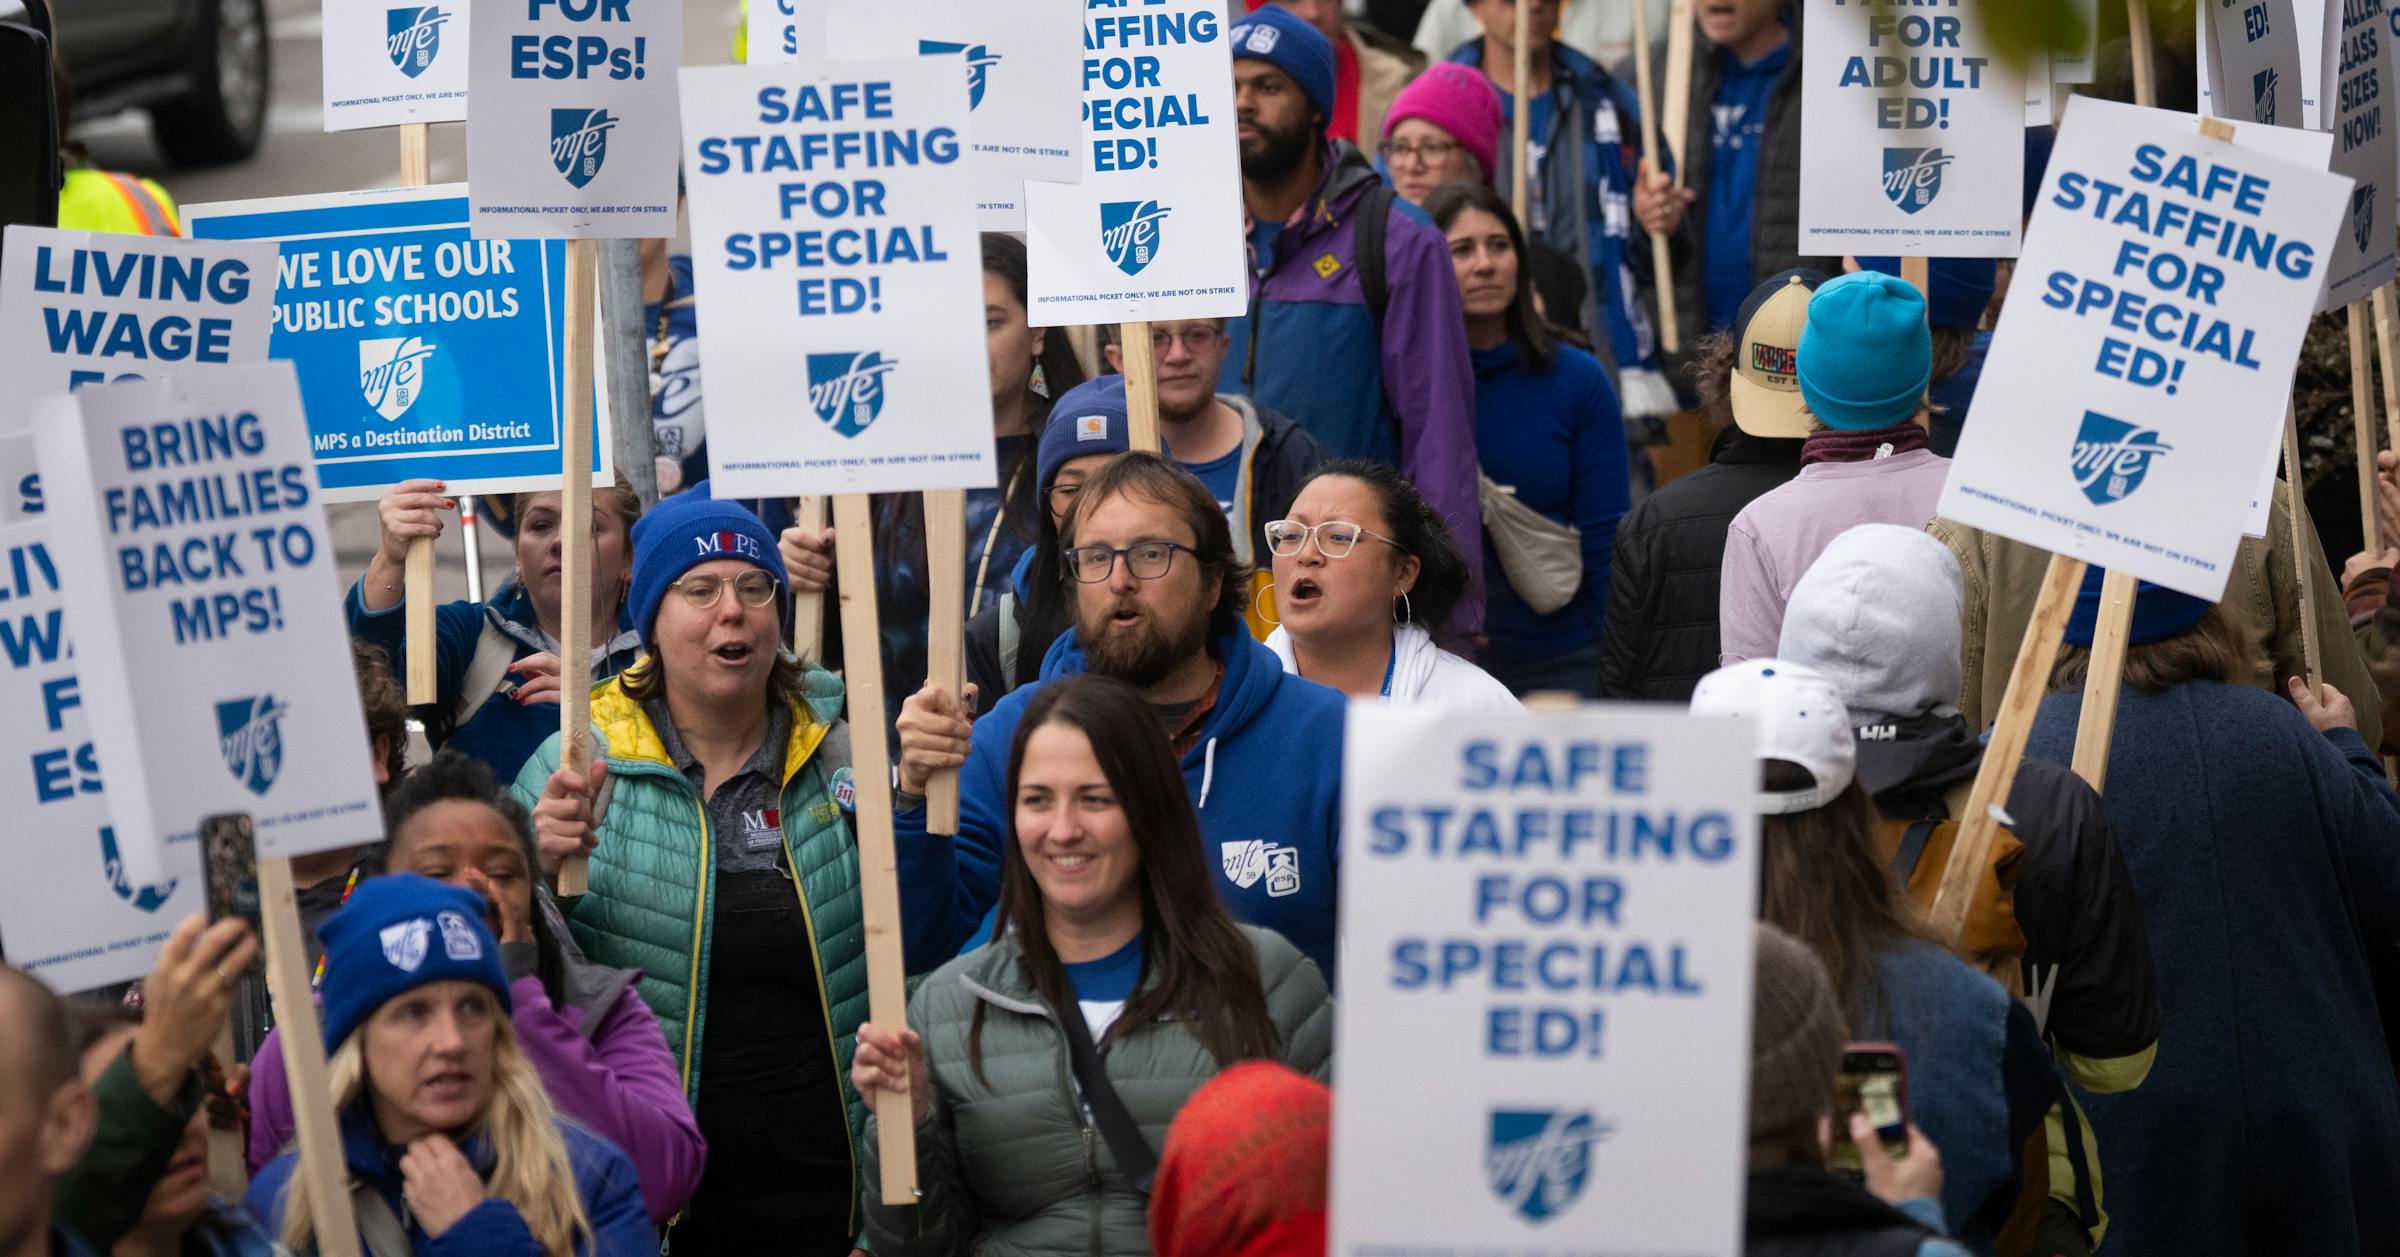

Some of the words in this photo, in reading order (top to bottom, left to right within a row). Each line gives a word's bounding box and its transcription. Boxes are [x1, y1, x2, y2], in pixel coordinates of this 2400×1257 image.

[1084, 11, 1218, 50] FFING
[1869, 15, 1961, 48] FOR
[2244, 2, 2270, 43] ED!
[511, 35, 646, 80] ESPs!
[1082, 56, 1161, 91] FOR
[1839, 56, 1988, 89] ADULT
[2339, 27, 2378, 74] LASS
[332, 97, 381, 108] INFORMATIONAL
[382, 95, 403, 103] PICKET
[757, 81, 893, 124] SAFE
[1082, 93, 1210, 132] ECIAL
[1877, 97, 1949, 130] ED!
[2341, 68, 2379, 114] SIZES
[698, 127, 960, 175] STAFFING
[1039, 148, 1069, 157] STRIKE
[2343, 106, 2381, 153] NOW!
[1093, 137, 1158, 172] ED!
[778, 179, 887, 220] FOR
[2129, 144, 2270, 217] SAFE
[479, 206, 540, 214] INFORMATIONAL
[542, 206, 568, 214] PICKET
[570, 206, 589, 215] ONLY,
[2052, 171, 2315, 280] STAFFING
[275, 252, 321, 289] WE
[331, 245, 425, 286] LOVE
[435, 240, 515, 277] OUR
[724, 225, 948, 271] SPECIAL
[34, 246, 249, 305] LIVING
[2113, 239, 2225, 306] FOR
[269, 298, 365, 335] PUBLIC
[374, 288, 520, 326] SCHOOLS
[797, 276, 882, 316] ED!
[1037, 294, 1098, 303] INFORMATIONAL
[1125, 292, 1146, 300] ONLY,
[43, 307, 232, 364] WAGE
[2041, 270, 2261, 371] SPECIAL
[2095, 336, 2187, 396] ED!
[120, 412, 266, 471] BRING
[315, 432, 347, 451] MPS
[351, 436, 361, 448] a
[366, 426, 463, 448] Destination
[469, 421, 531, 442] District
[104, 465, 311, 534] FAMILIES
[118, 532, 244, 592] BACK
[251, 523, 315, 572] TO
[169, 585, 285, 645] MPS!
[1859, 725, 1897, 741] HH
[1459, 738, 1649, 792] SAFE
[1367, 806, 1737, 863] STAFFING
[1246, 871, 1256, 880] 59
[1274, 874, 1293, 883] esp
[1474, 873, 1626, 926] FOR
[1388, 939, 1706, 998] SPECIAL
[1485, 1005, 1606, 1058] ED!
